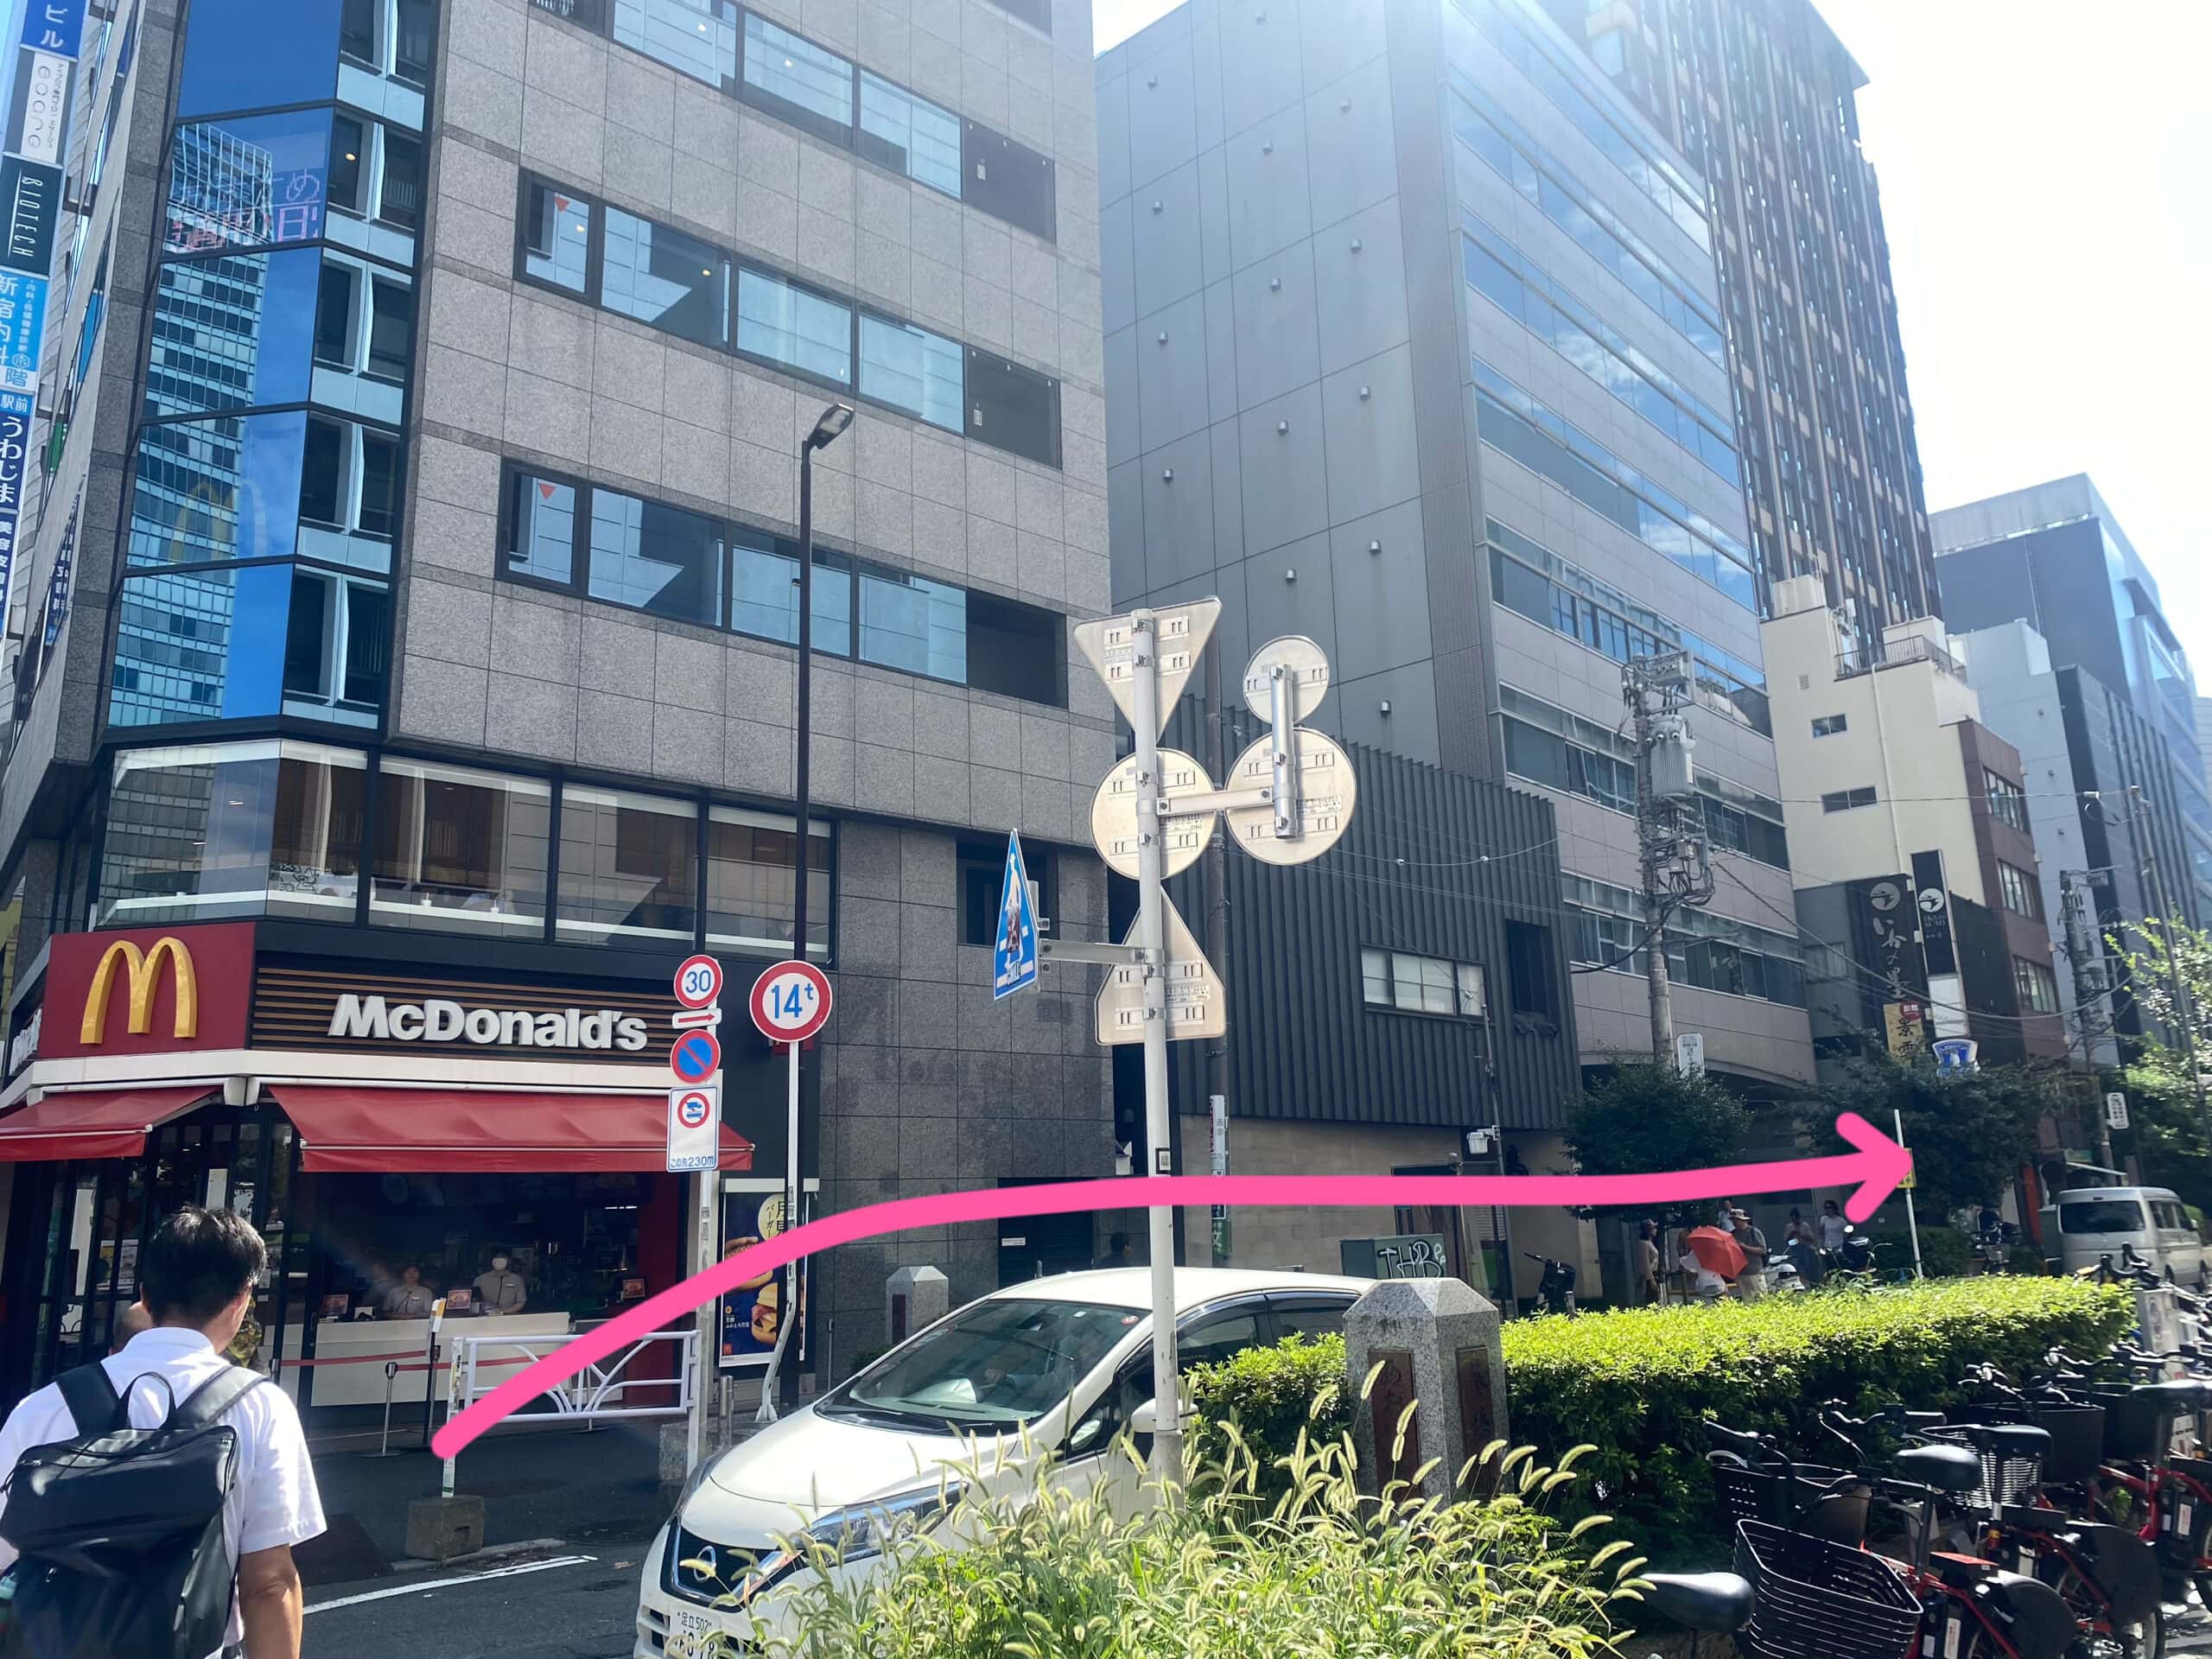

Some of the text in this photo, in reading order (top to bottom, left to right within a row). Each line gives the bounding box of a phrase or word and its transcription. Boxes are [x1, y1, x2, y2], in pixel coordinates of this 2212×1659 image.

[40, 3, 68, 48] ビル
[11, 175, 44, 257] BIOTECH
[1, 393, 29, 413] 駅前
[0, 416, 23, 504] うわじま
[685, 969, 711, 994] 30
[327, 994, 648, 1052] McDonald's
[671, 1155, 715, 1167] この先230m
